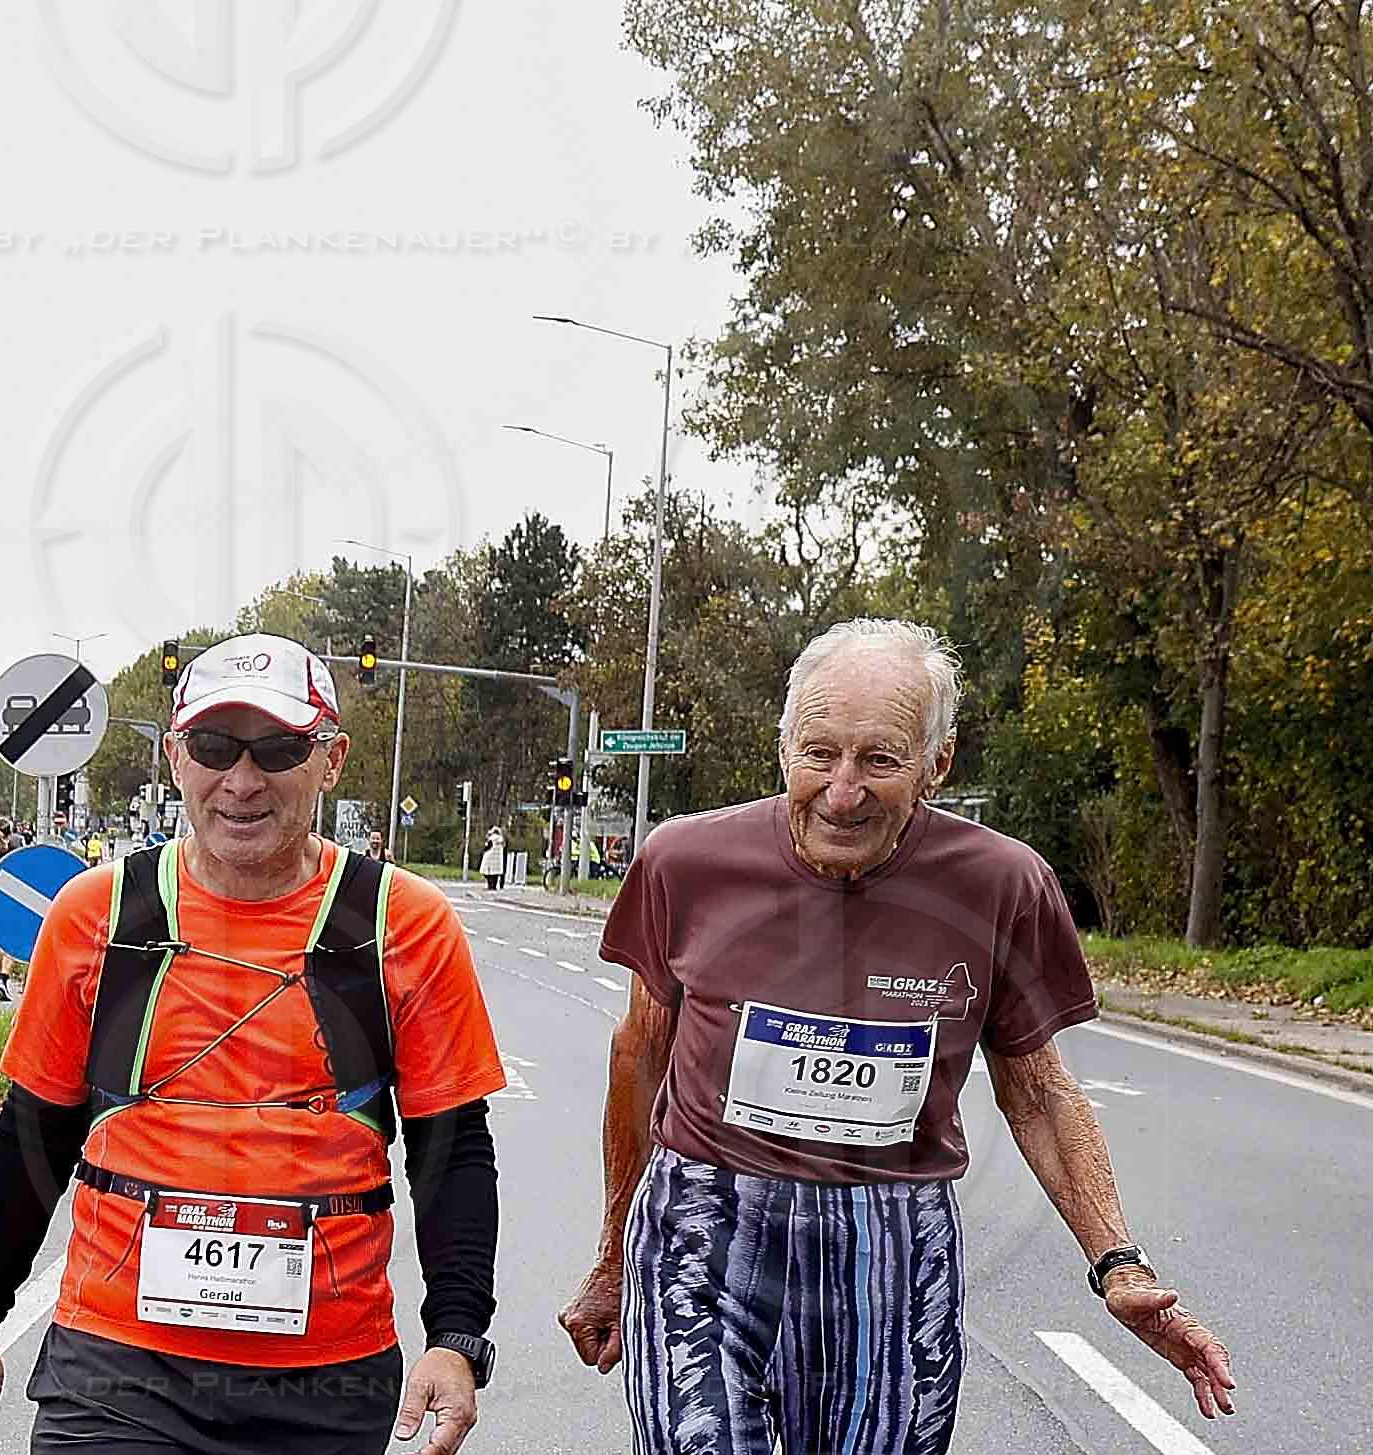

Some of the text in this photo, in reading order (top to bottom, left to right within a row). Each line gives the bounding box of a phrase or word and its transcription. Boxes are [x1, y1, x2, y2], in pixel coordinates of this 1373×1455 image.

[893, 978, 938, 992] GRAZ
[881, 990, 923, 999] MARATHON
[785, 1022, 817, 1035] GRAZ
[781, 1031, 847, 1048] MARATHON
[791, 1055, 876, 1088] 1820
[179, 1204, 207, 1216] GRAZ
[176, 1212, 235, 1228] MARATHON
[184, 1239, 265, 1270] 4617
[199, 1288, 243, 1302] Gerald
